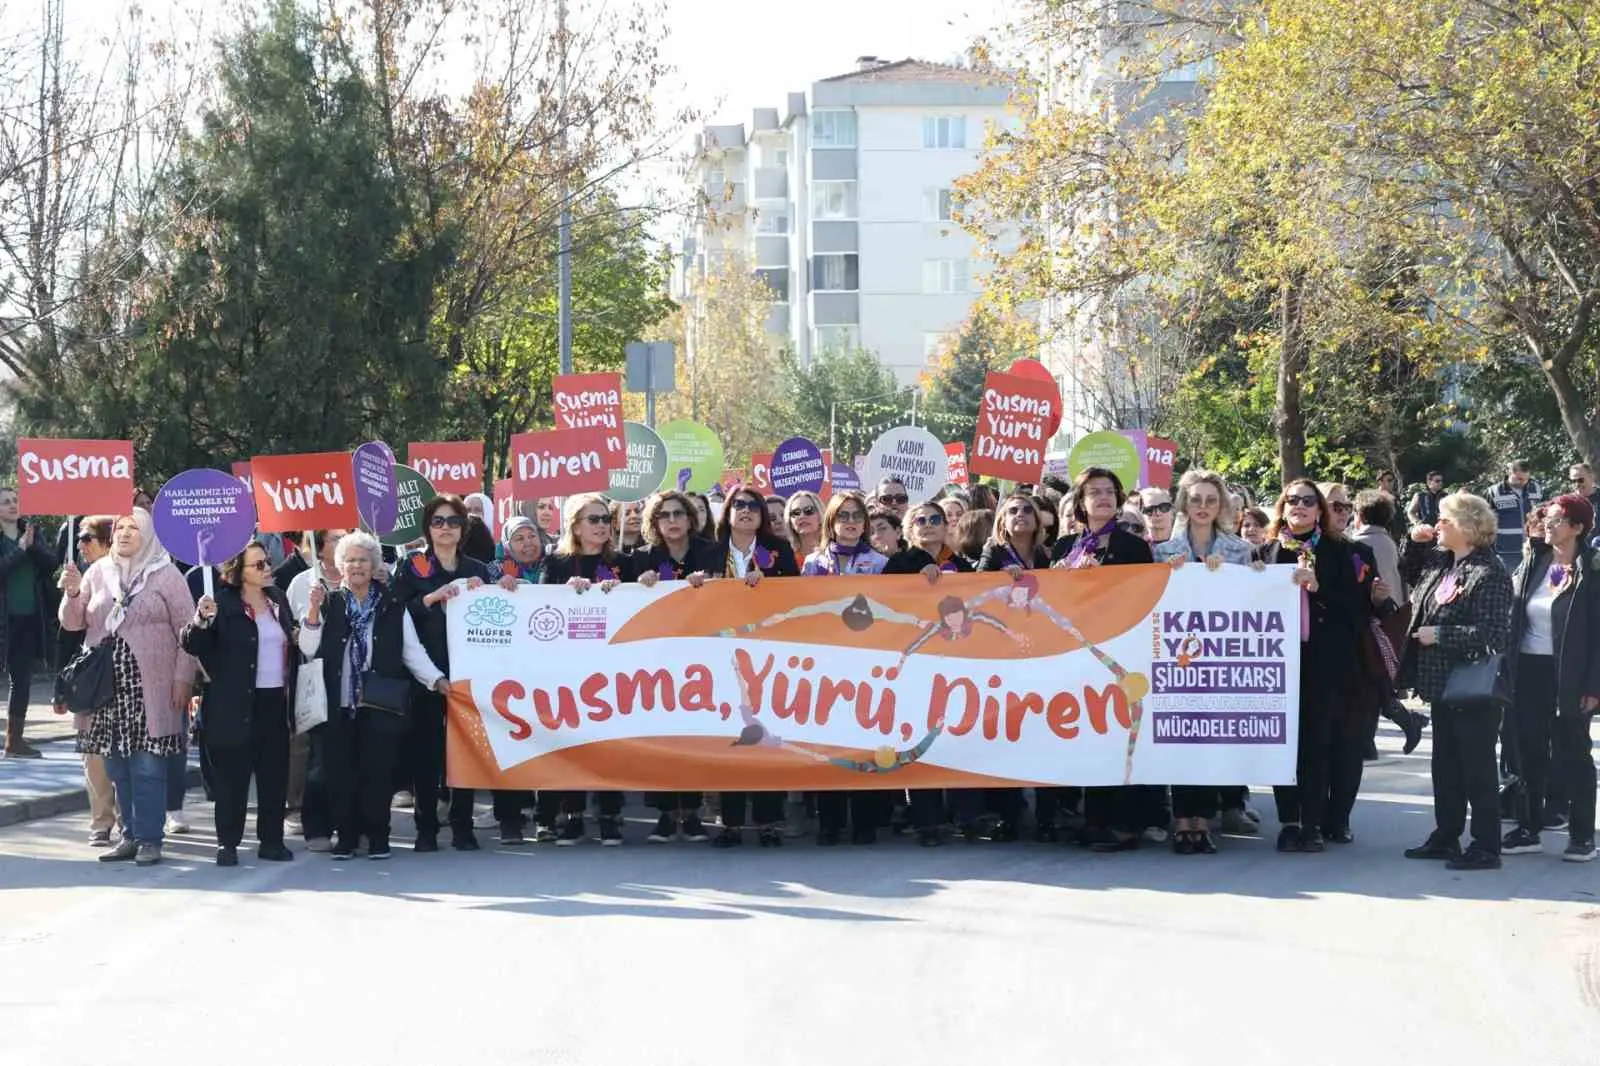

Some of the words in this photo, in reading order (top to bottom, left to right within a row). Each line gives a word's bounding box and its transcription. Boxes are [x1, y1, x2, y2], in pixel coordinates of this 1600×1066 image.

[556, 389, 619, 413] Susma
[985, 388, 1050, 417] Susma
[562, 407, 617, 429] Yürü
[986, 412, 1042, 440] Yürü
[897, 440, 924, 457] KADIN
[977, 435, 1039, 465] Diren
[20, 451, 130, 485] Susma
[414, 458, 476, 480] Diren
[518, 450, 601, 481] Diren
[626, 458, 653, 474] ERÇEK
[880, 453, 936, 477] DAYANIŞMASI
[396, 480, 419, 497] ALET
[609, 473, 640, 488] ADALET
[223, 497, 236, 505] VE
[262, 472, 344, 513] Yürü
[398, 495, 424, 513] ERÇEK
[189, 516, 221, 525] DEVAM
[467, 628, 512, 637] NİLÜFER
[1164, 611, 1285, 633] KADINA
[466, 636, 512, 644] BELEDİYESİ
[1164, 633, 1285, 659] YÖNELİK
[1155, 663, 1229, 692] ŞİDDETE
[1231, 666, 1281, 692] KARŞI
[492, 663, 731, 740] Susma,
[735, 648, 913, 742] Yürü,
[927, 673, 1132, 742] Diren
[1156, 715, 1237, 738] MÜCADELE
[1239, 715, 1280, 738] GÜNÜ
